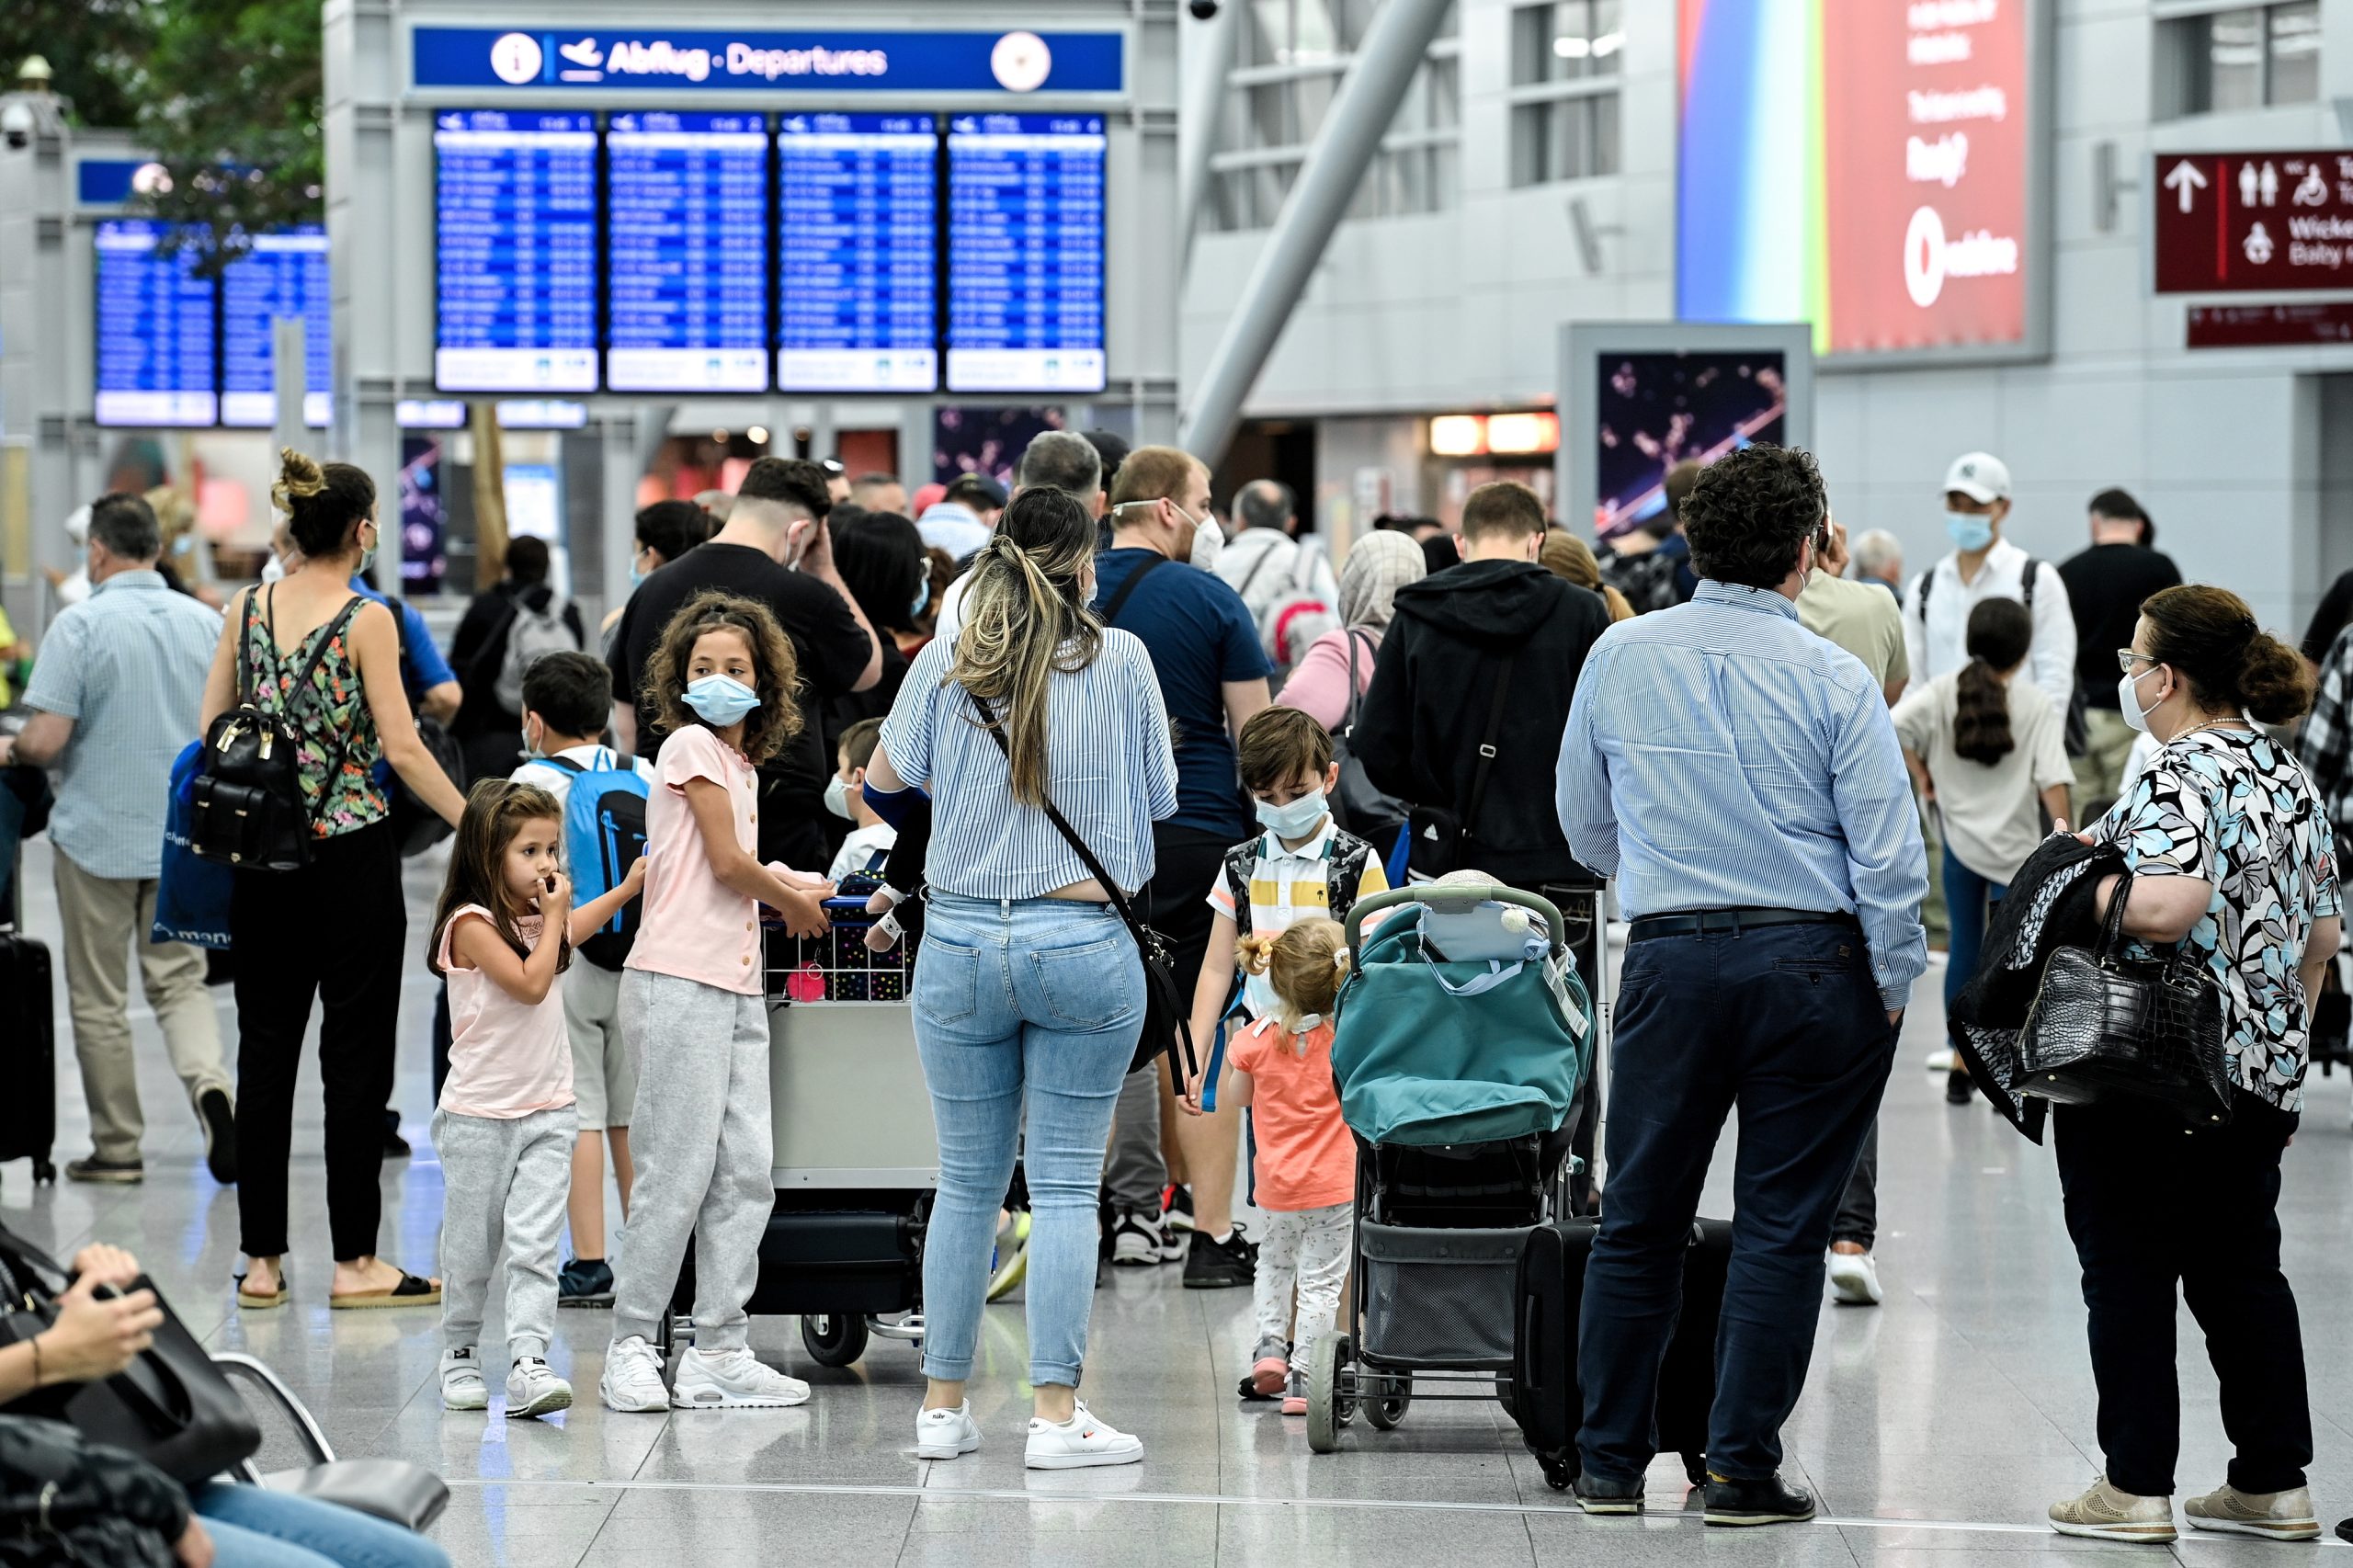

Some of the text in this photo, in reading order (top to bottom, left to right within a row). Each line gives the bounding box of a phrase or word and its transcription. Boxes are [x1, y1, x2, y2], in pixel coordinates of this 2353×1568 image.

[607, 40, 888, 82] Abflug Departures
[2289, 240, 2343, 270] Baby
